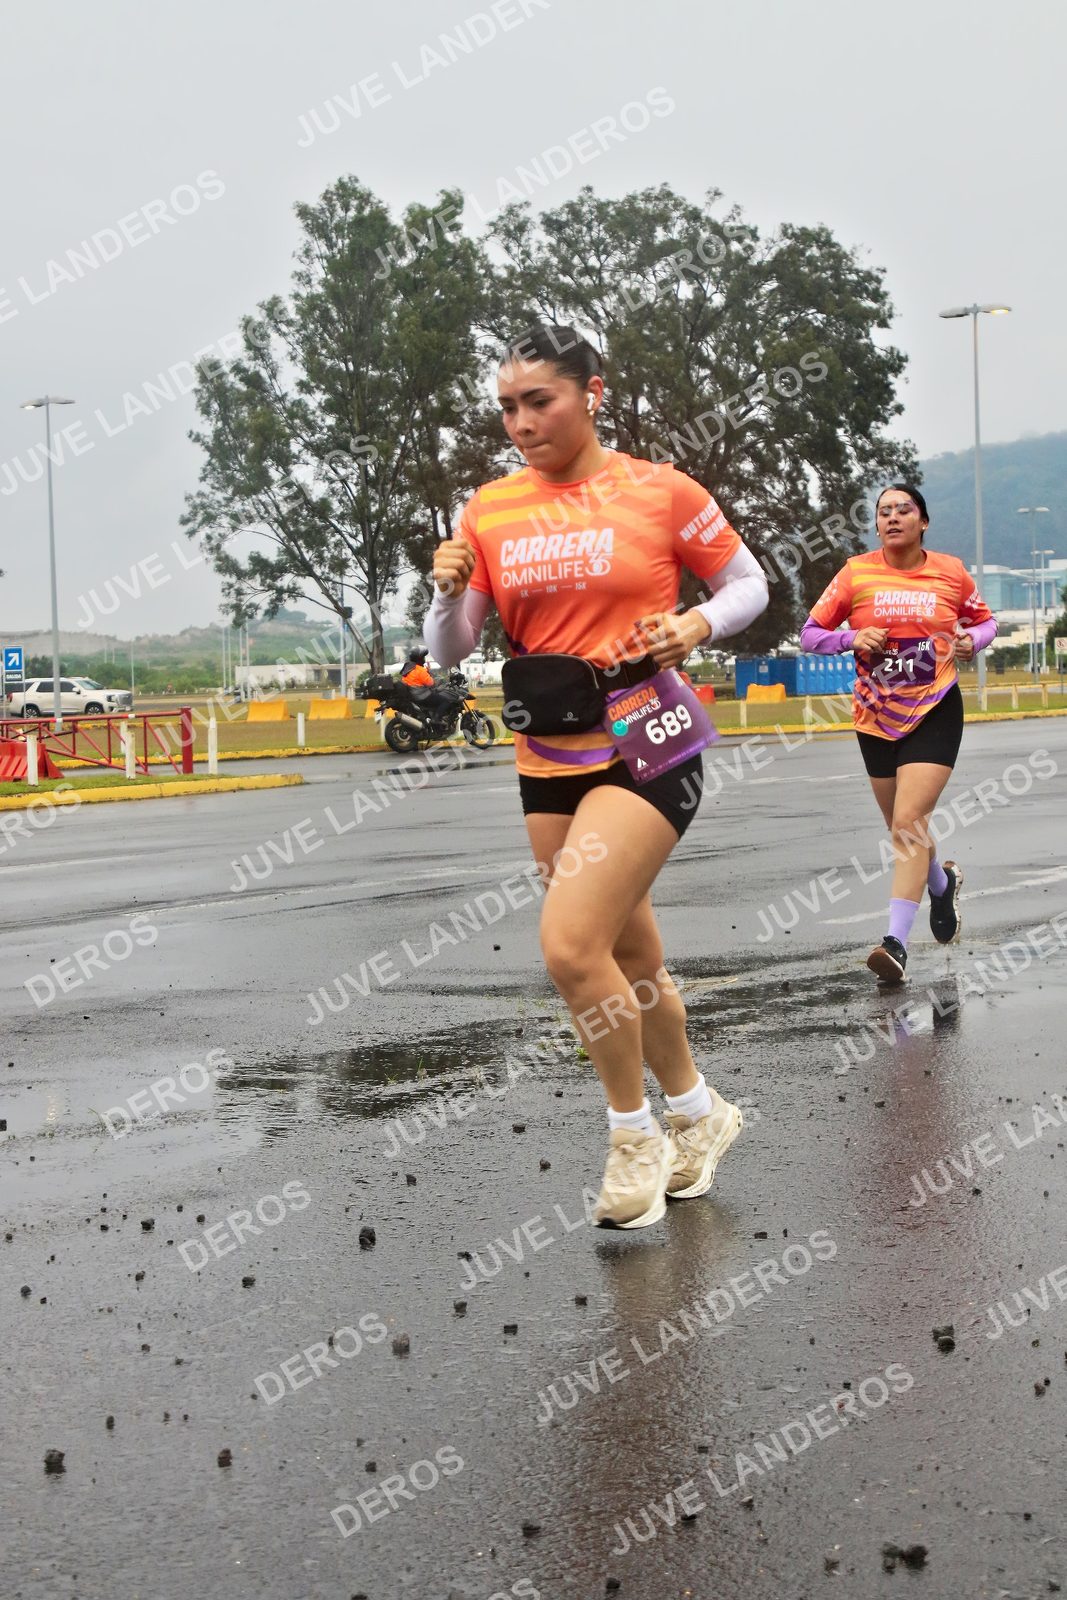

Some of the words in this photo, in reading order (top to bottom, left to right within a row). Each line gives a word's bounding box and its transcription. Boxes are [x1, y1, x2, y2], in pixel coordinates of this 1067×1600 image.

[500, 528, 614, 567] CARRERA
[501, 560, 584, 589] OMNILIFE
[874, 591, 937, 606] CARRERA
[874, 606, 922, 618] OMNILIFE
[918, 641, 930, 651] 15K
[884, 658, 914, 672] 211
[607, 686, 658, 722] CARRERA
[621, 704, 653, 727] MNILIFE
[645, 704, 692, 745] 689
